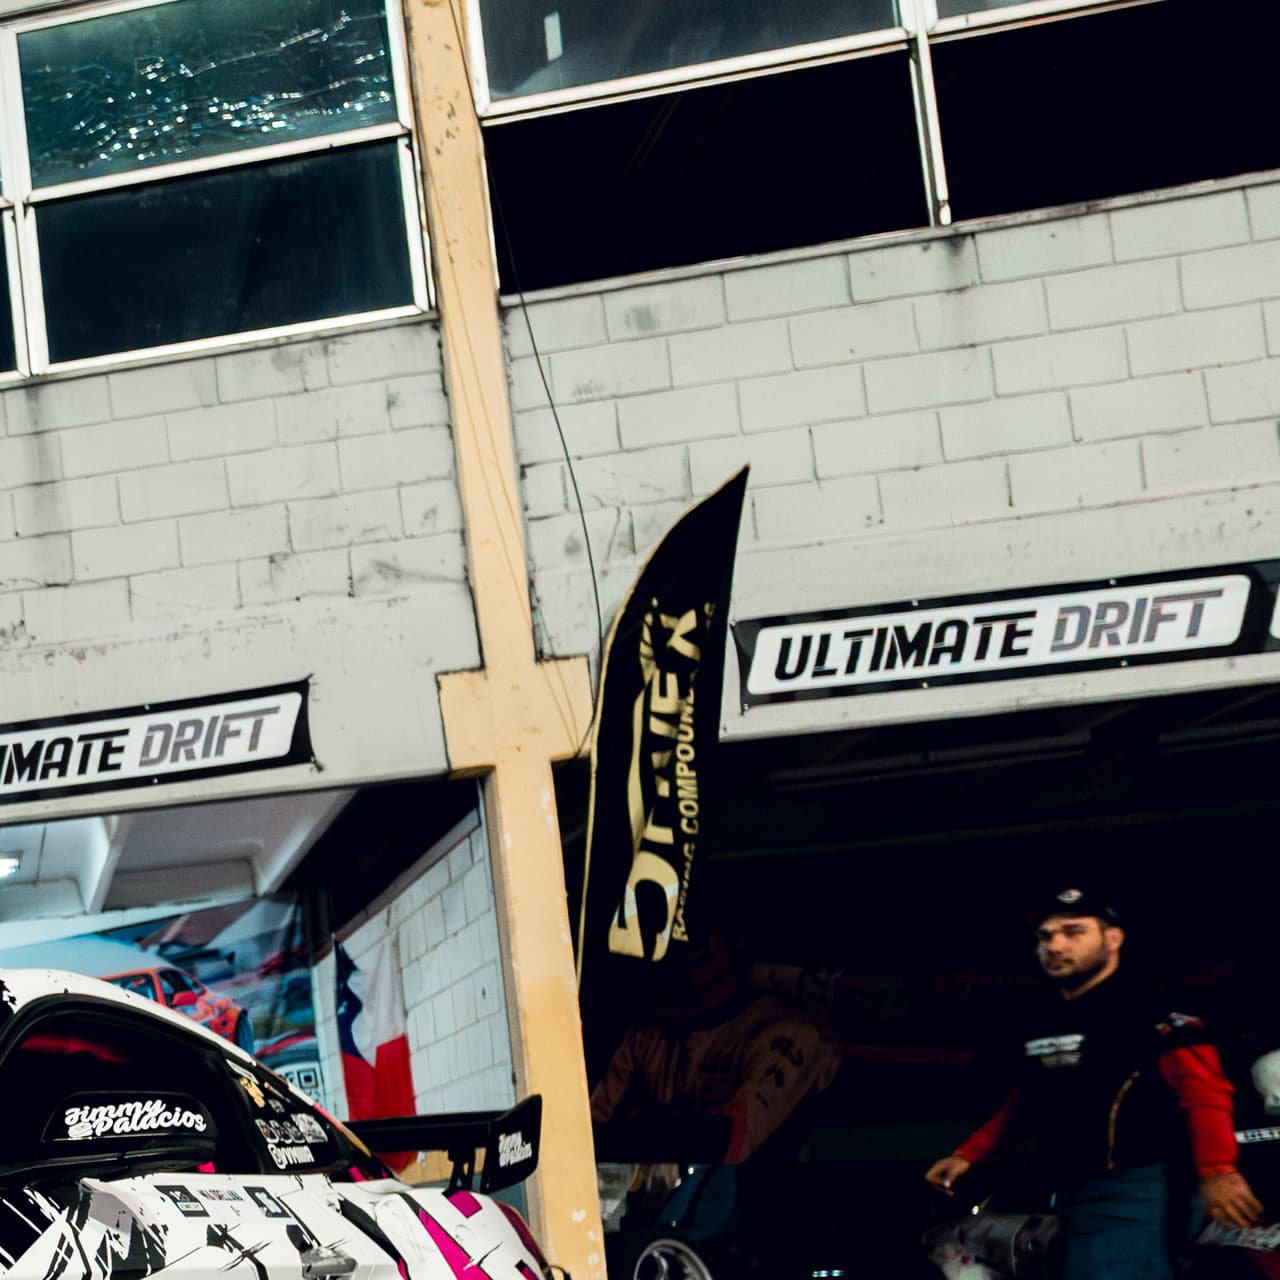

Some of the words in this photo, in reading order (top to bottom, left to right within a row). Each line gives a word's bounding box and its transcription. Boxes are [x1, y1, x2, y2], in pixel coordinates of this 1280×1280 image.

[775, 611, 1037, 680] ULTIMATE
[1051, 590, 1222, 652] DRIFT
[140, 706, 280, 766] DRIFT
[64, 1099, 167, 1126] Jimmy
[91, 1107, 207, 1137] Palacios
